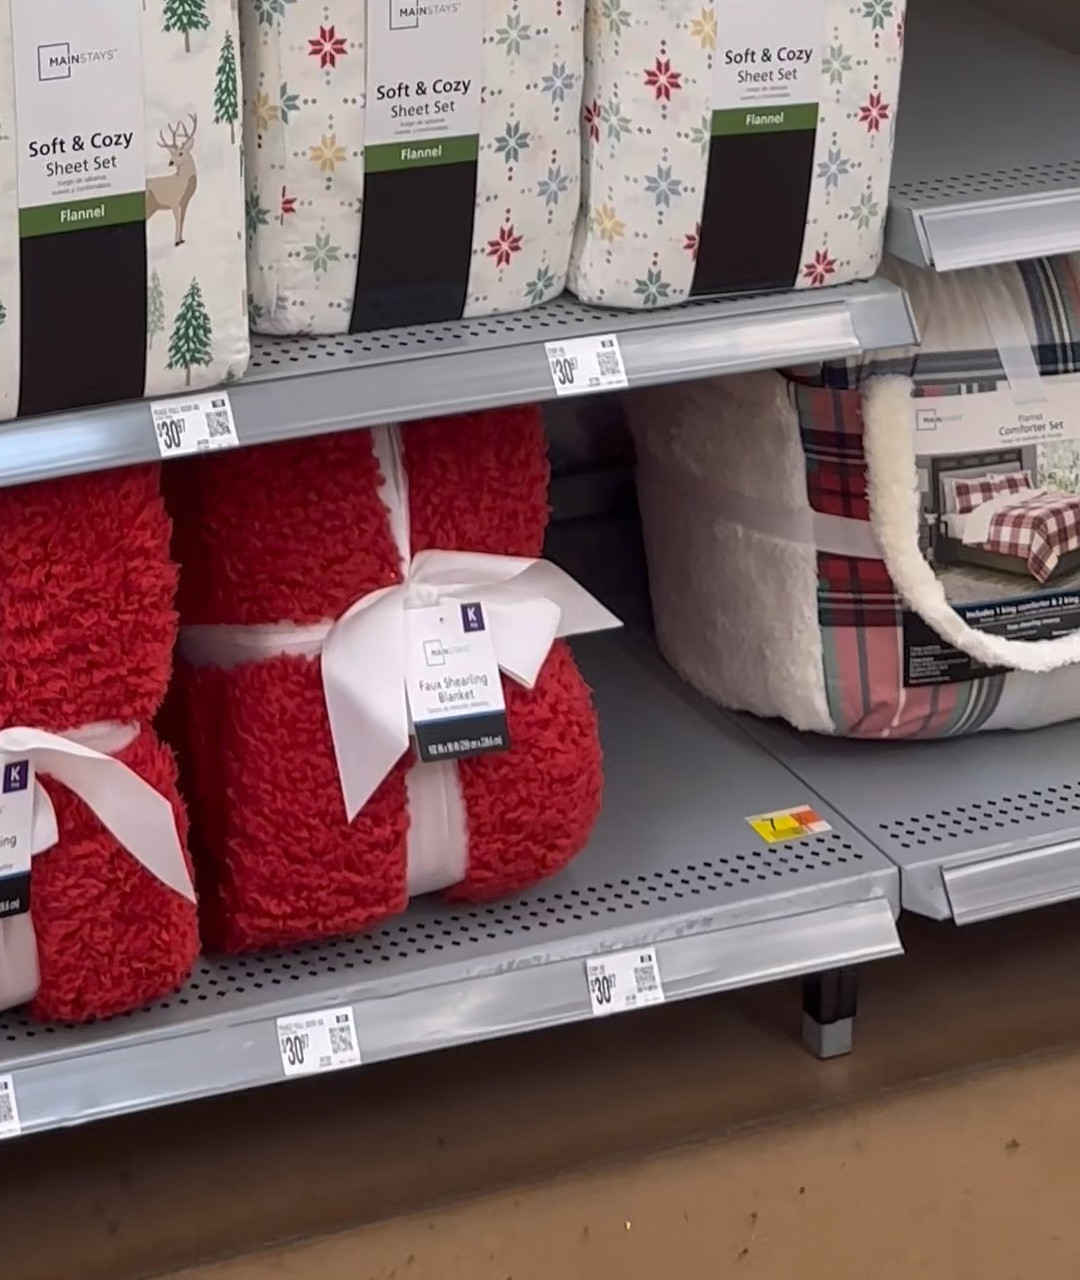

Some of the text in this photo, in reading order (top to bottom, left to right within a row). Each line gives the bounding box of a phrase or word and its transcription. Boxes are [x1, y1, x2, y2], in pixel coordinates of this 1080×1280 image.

[399, 2, 458, 17] MAINSTAYS
[49, 50, 114, 67] MAINSTAYS
[725, 47, 813, 65] Soft & Cozy
[737, 68, 797, 83] Sheet Set
[376, 79, 471, 100] Soft & Cozy
[391, 100, 455, 118] Sheet Set
[745, 112, 784, 126] Flannel
[29, 132, 133, 157] Soft & Cozy
[401, 145, 442, 160] Flannel
[46, 155, 117, 177] Sheet Set
[60, 204, 105, 222] Flannel
[999, 420, 1064, 437] Comforter Set
[467, 607, 476, 621] K
[420, 673, 488, 691] Faux Shearling
[438, 690, 474, 703] Blanket
[10, 766, 20, 781] K
